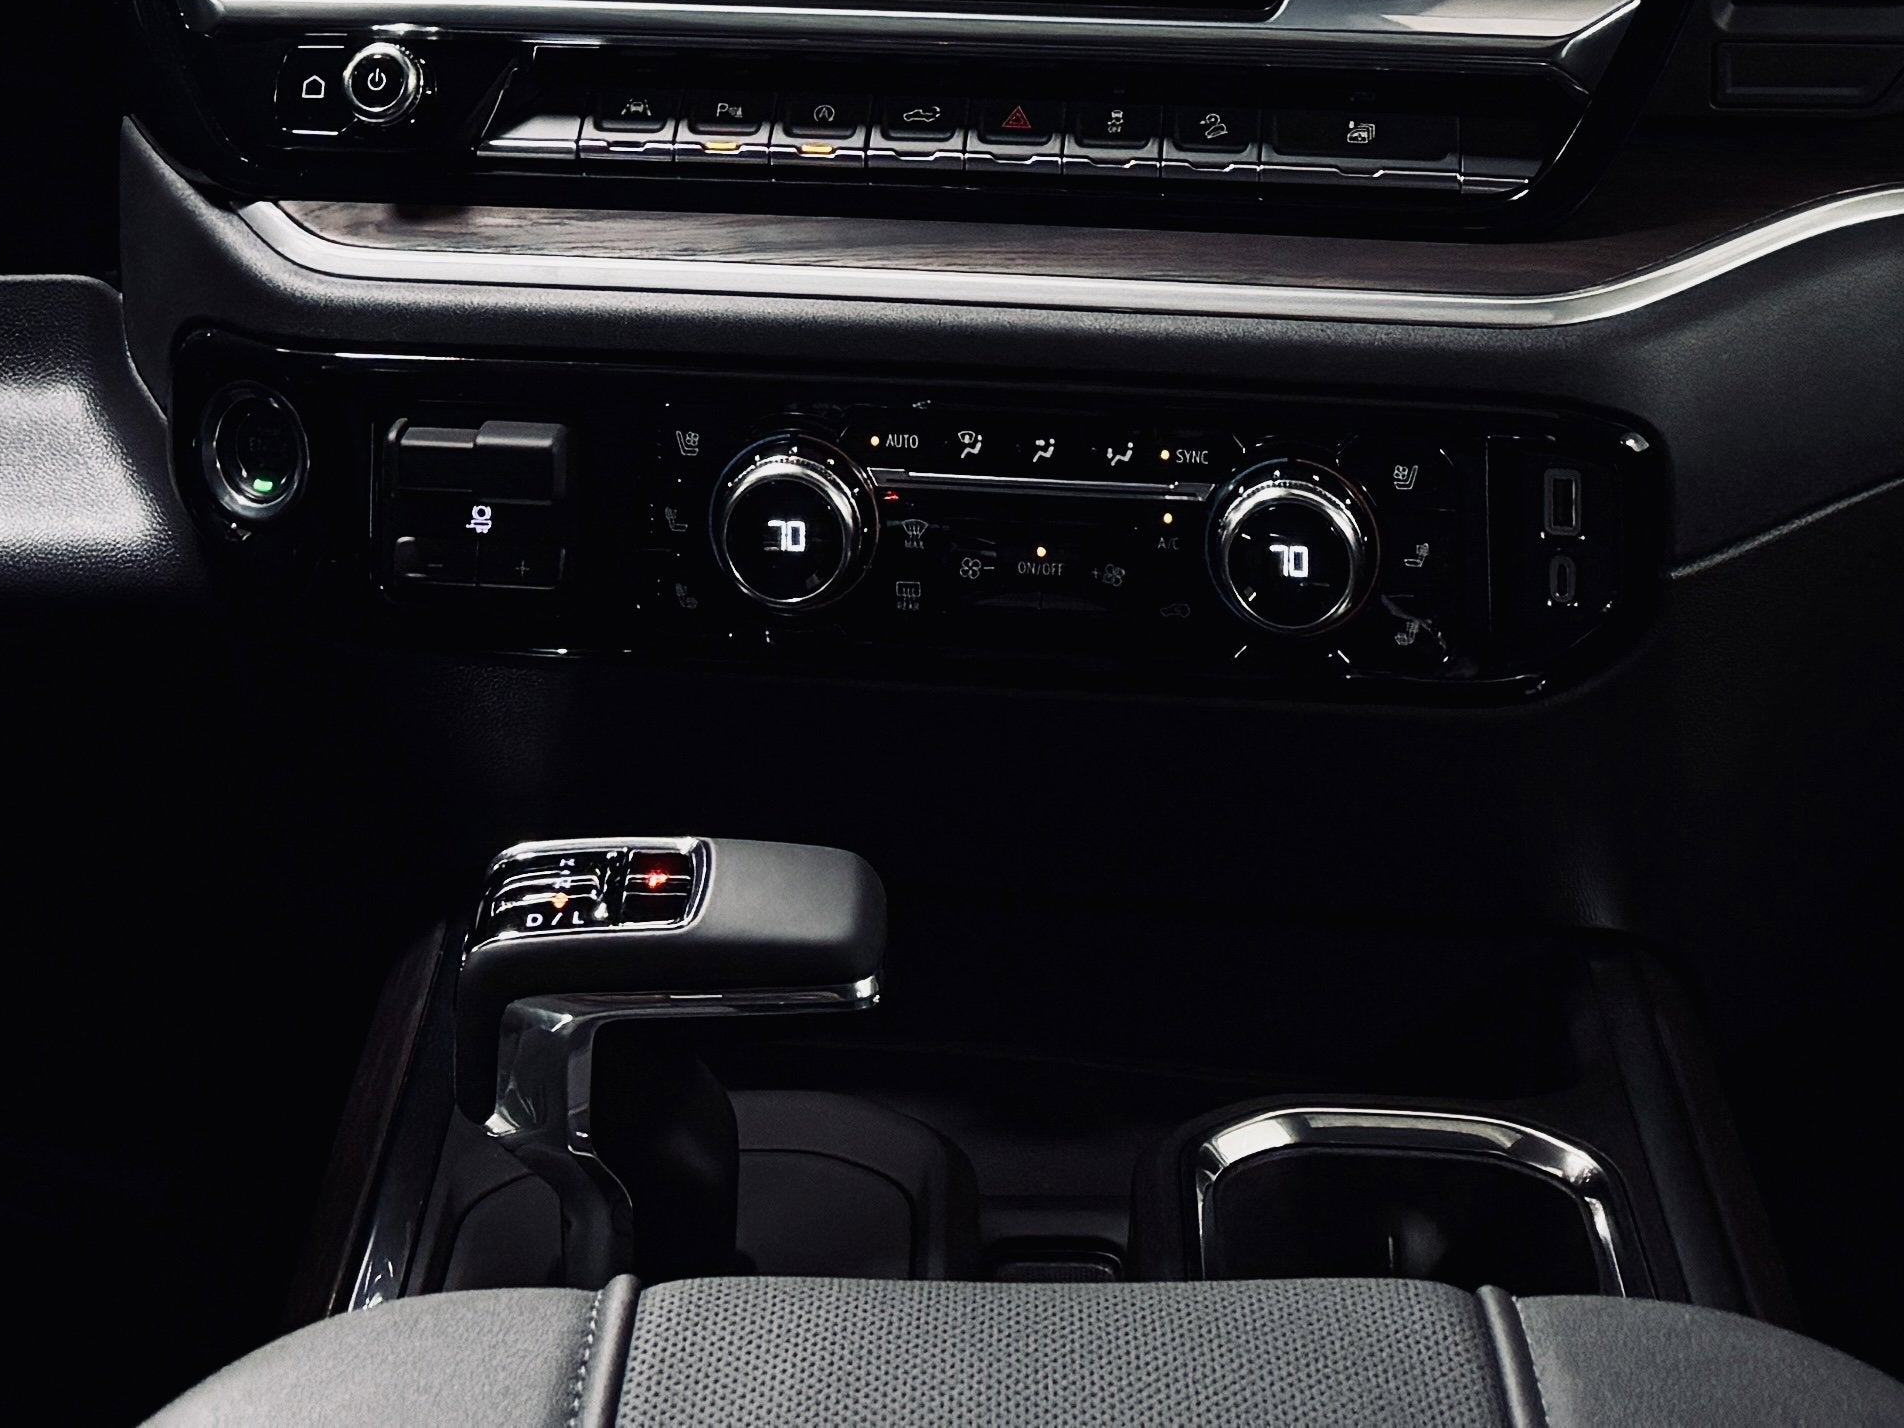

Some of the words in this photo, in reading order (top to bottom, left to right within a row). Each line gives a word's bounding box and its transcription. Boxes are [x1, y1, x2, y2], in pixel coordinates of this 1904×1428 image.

[885, 434, 919, 449] AUTO
[1175, 450, 1209, 465] SYNC
[766, 519, 806, 552] 70
[1157, 537, 1180, 549] A/C
[1269, 545, 1309, 577] 70
[1017, 562, 1063, 577] ON/OFF
[526, 913, 543, 926] D
[572, 911, 584, 925] L
